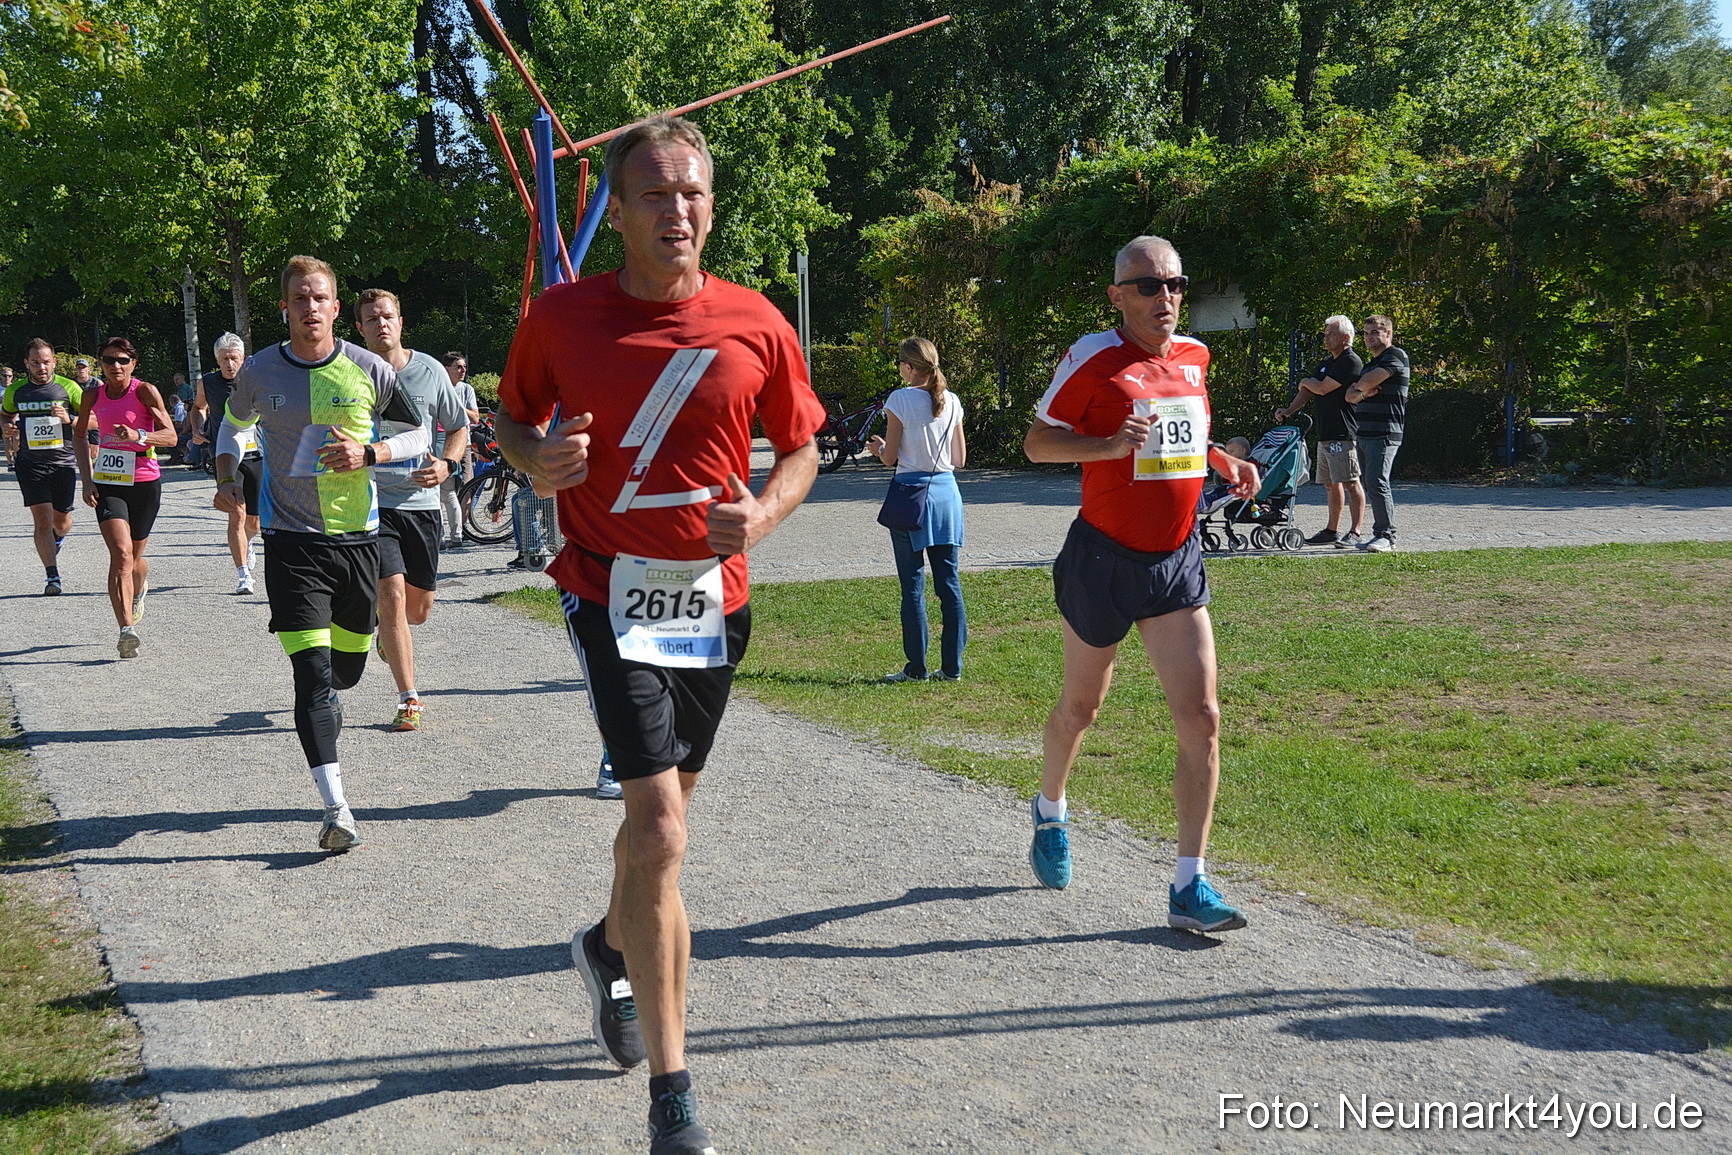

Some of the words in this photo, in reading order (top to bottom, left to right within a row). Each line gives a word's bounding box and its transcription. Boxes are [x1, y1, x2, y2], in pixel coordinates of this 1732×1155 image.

[33, 425, 54, 436] 282
[1155, 420, 1192, 446] 193
[1329, 441, 1342, 454] 86
[102, 454, 124, 468] 206
[1159, 459, 1192, 471] Markus
[646, 568, 694, 581] BOCK
[624, 588, 706, 620] 2615
